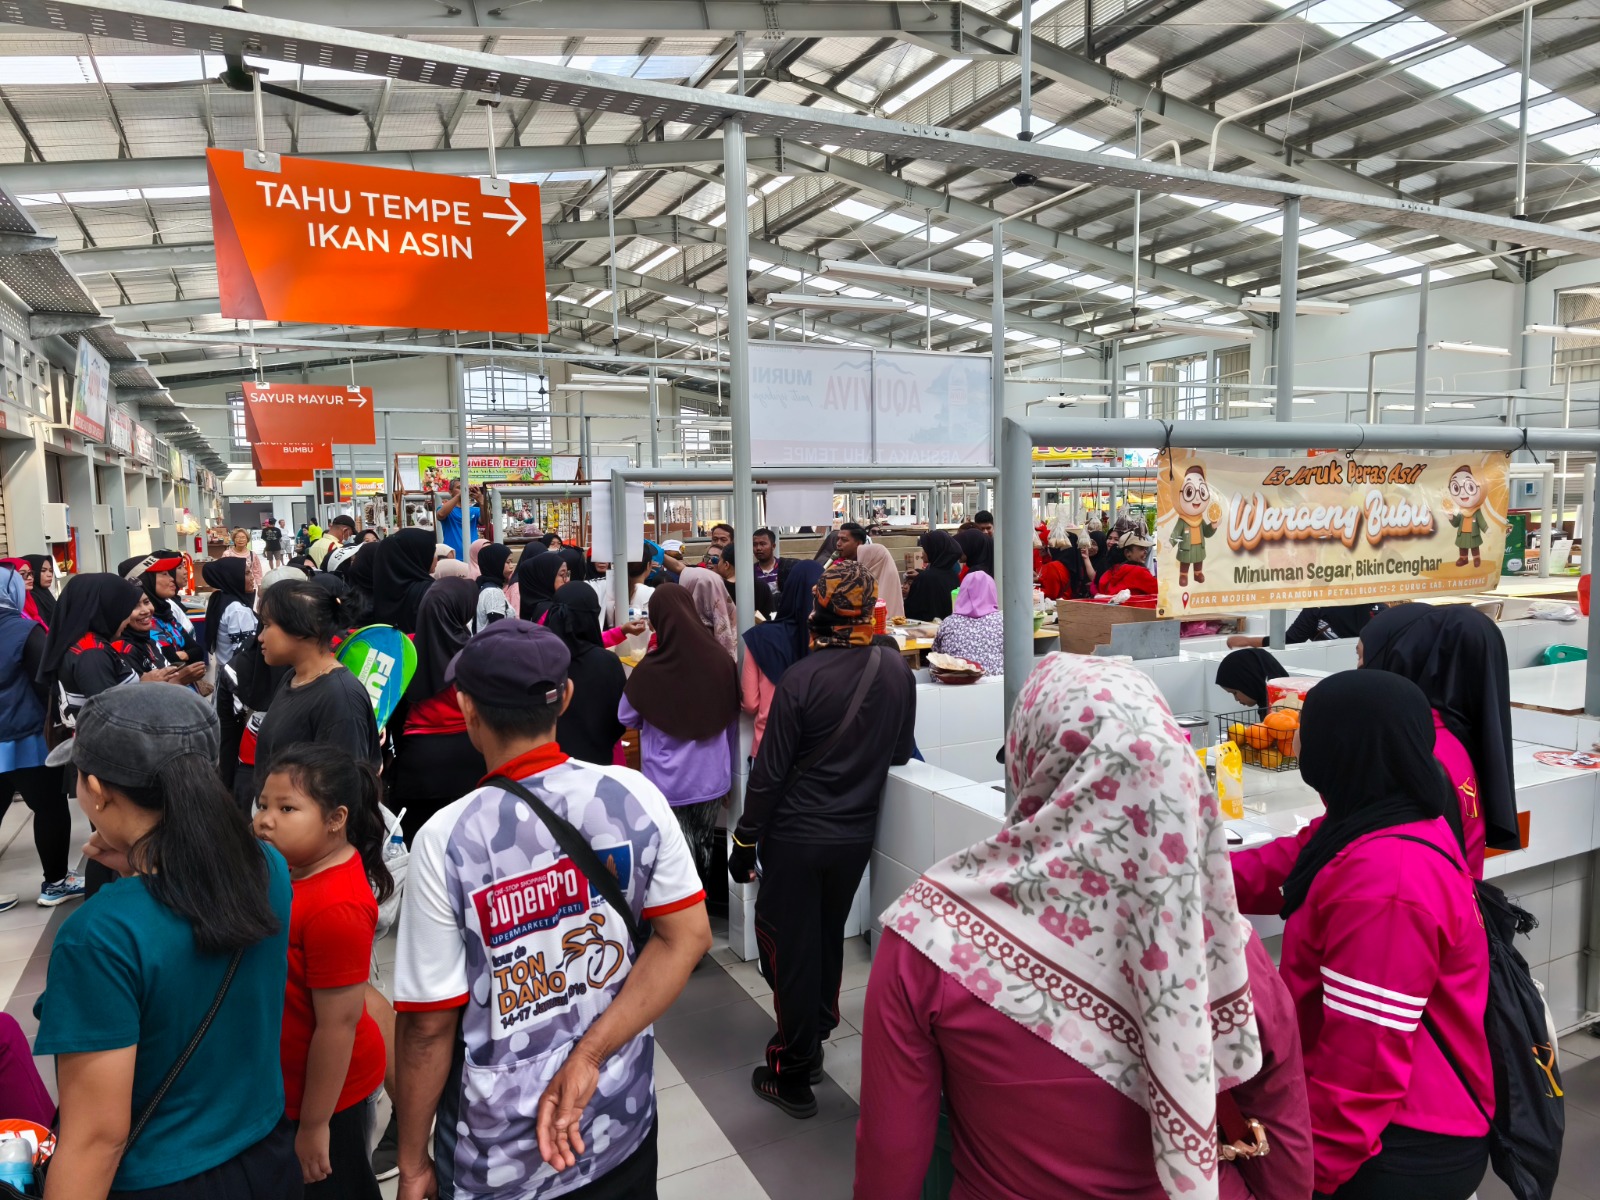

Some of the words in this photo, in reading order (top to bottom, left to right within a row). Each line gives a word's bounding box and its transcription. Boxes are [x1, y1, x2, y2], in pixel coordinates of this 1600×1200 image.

[255, 180, 352, 214] TAHU
[360, 191, 472, 226] TEMPE
[308, 222, 390, 253] IKAN
[399, 231, 473, 260] ASIN
[250, 392, 295, 404] SAYUR
[298, 394, 344, 405] MAYUR
[503, 459, 537, 468] REJEKI
[1263, 466, 1290, 485] Es
[1285, 460, 1343, 486] Jeruk
[1347, 460, 1388, 484] Peras
[1388, 463, 1427, 485] Asli
[1228, 491, 1361, 547] Waroeng
[1365, 490, 1433, 542] Bubu
[1234, 566, 1304, 584] Minuman
[1307, 561, 1354, 582] Segar,
[1355, 559, 1385, 577] Bikin
[1386, 556, 1442, 576] Cenghar
[1270, 589, 1323, 600] PARAMOUNT
[520, 874, 547, 889] SHOPPING
[491, 918, 550, 945] UPERMARKET
[494, 951, 546, 991] TON
[498, 970, 567, 1016] DANO
[501, 1006, 531, 1029] 14-17
